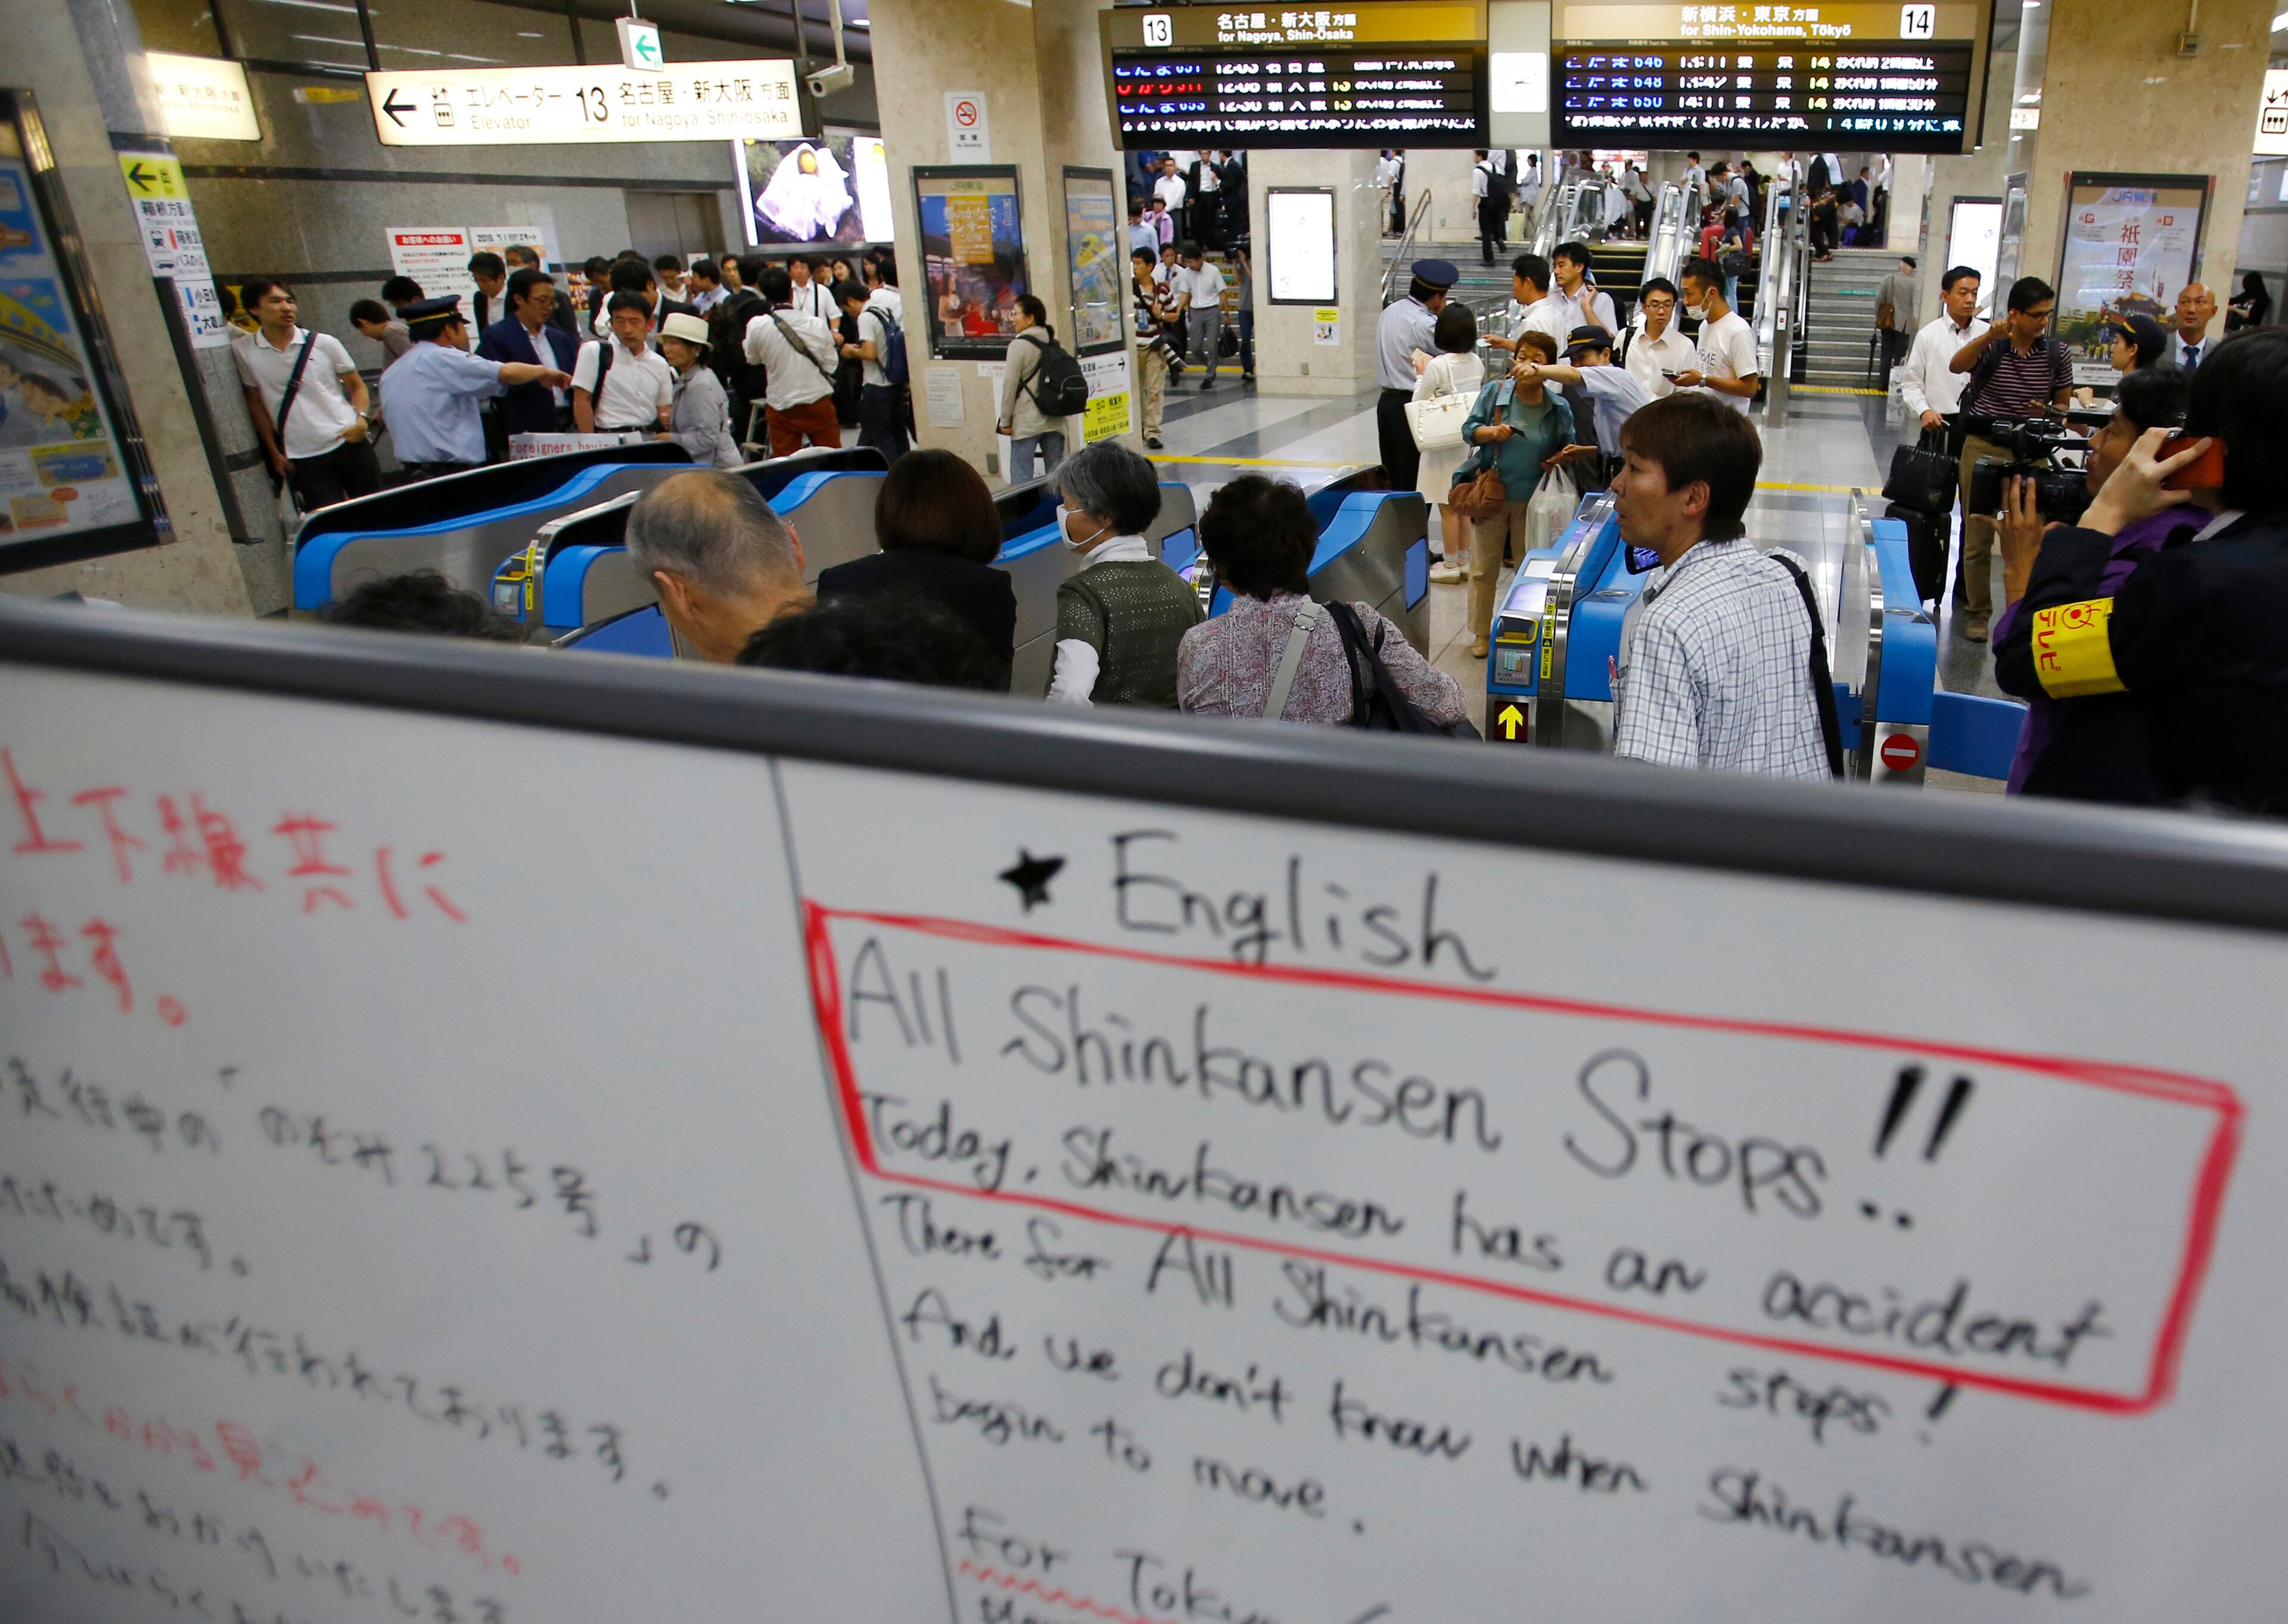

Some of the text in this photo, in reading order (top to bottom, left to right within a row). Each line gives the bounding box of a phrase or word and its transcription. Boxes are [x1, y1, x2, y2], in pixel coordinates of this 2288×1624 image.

[1147, 19, 1168, 42] 13
[1680, 23, 1852, 39] for Shin-Yokohama, Tōkyō
[1906, 10, 1929, 34] 14
[1217, 30, 1235, 42] for
[1237, 30, 1285, 45] Nagoya,
[1811, 56, 1831, 69] 14
[1810, 77, 1830, 89] 14
[466, 85, 562, 107] エレベーター
[576, 86, 608, 122] 13
[1808, 97, 1829, 110] 14
[471, 115, 531, 129] Elevator
[623, 113, 640, 127] for
[944, 221, 997, 234] コンサート
[510, 441, 573, 455] Foreigners
[1109, 830, 1498, 984] English
[848, 937, 962, 1065] All
[999, 983, 1503, 1153] Shinkansen
[1061, 1122, 1405, 1240] Shinkansen
[1450, 1187, 1565, 1275] has
[1604, 1245, 1709, 1296] an
[1761, 1274, 2115, 1371] accident
[879, 1193, 1002, 1263] There
[1022, 1215, 1113, 1282] for
[1145, 1224, 1237, 1308] All
[1274, 1255, 1615, 1386] Shinkansen
[929, 1374, 1068, 1447] begin
[1089, 1415, 1152, 1476] to
[1154, 1349, 1297, 1423] don't
[1328, 1380, 1472, 1463] know
[1510, 1430, 1649, 1495] when
[1697, 1464, 2094, 1604] Shinkansen
[956, 1505, 1071, 1572] For
[1112, 1547, 1279, 1624] Tok
